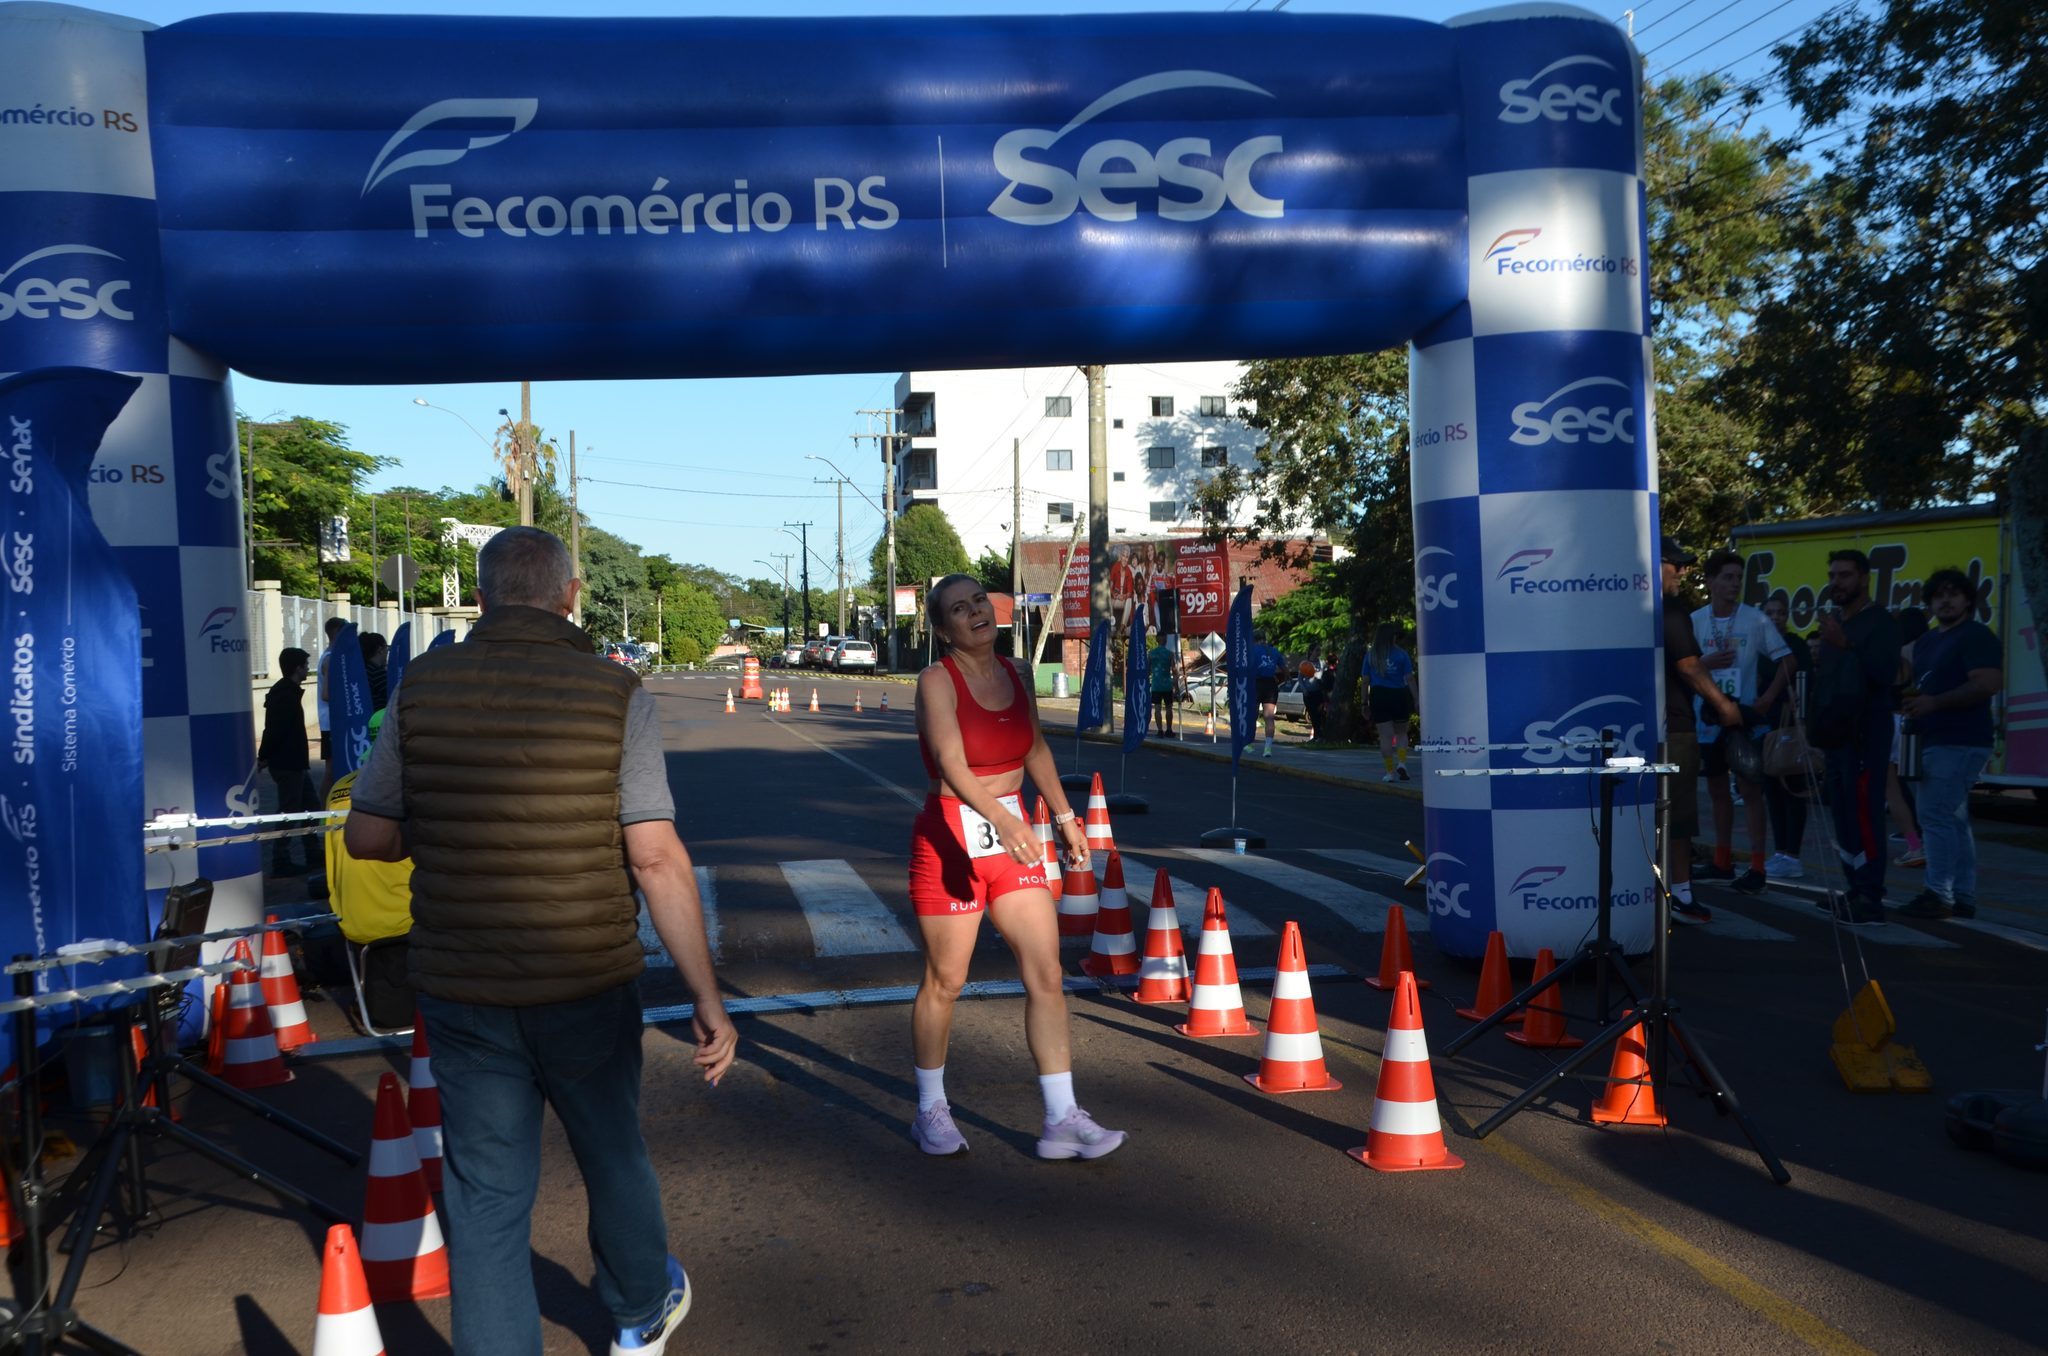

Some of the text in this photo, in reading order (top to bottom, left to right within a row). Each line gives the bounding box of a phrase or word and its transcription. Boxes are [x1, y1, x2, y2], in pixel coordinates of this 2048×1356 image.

[0, 103, 138, 132] mércio RS
[1498, 79, 1622, 126] Sesc
[988, 128, 1285, 226] Sesc
[410, 176, 899, 239] Fecomércio RS
[1498, 254, 1638, 278] Fecomércio RS
[1445, 422, 1468, 443] RS
[1509, 402, 1635, 446] Sesc
[10, 415, 33, 495] Senac
[131, 464, 165, 484] RS
[11, 531, 34, 596] Sesc
[1510, 573, 1650, 595] Fecomércio RS
[10, 633, 35, 765] Sindicatos
[60, 637, 77, 772] Sistema Comércio
[19, 803, 37, 838] RS
[977, 821, 1003, 850] 8
[951, 899, 978, 912] RUN
[1523, 888, 1640, 910] Fecomrcio
